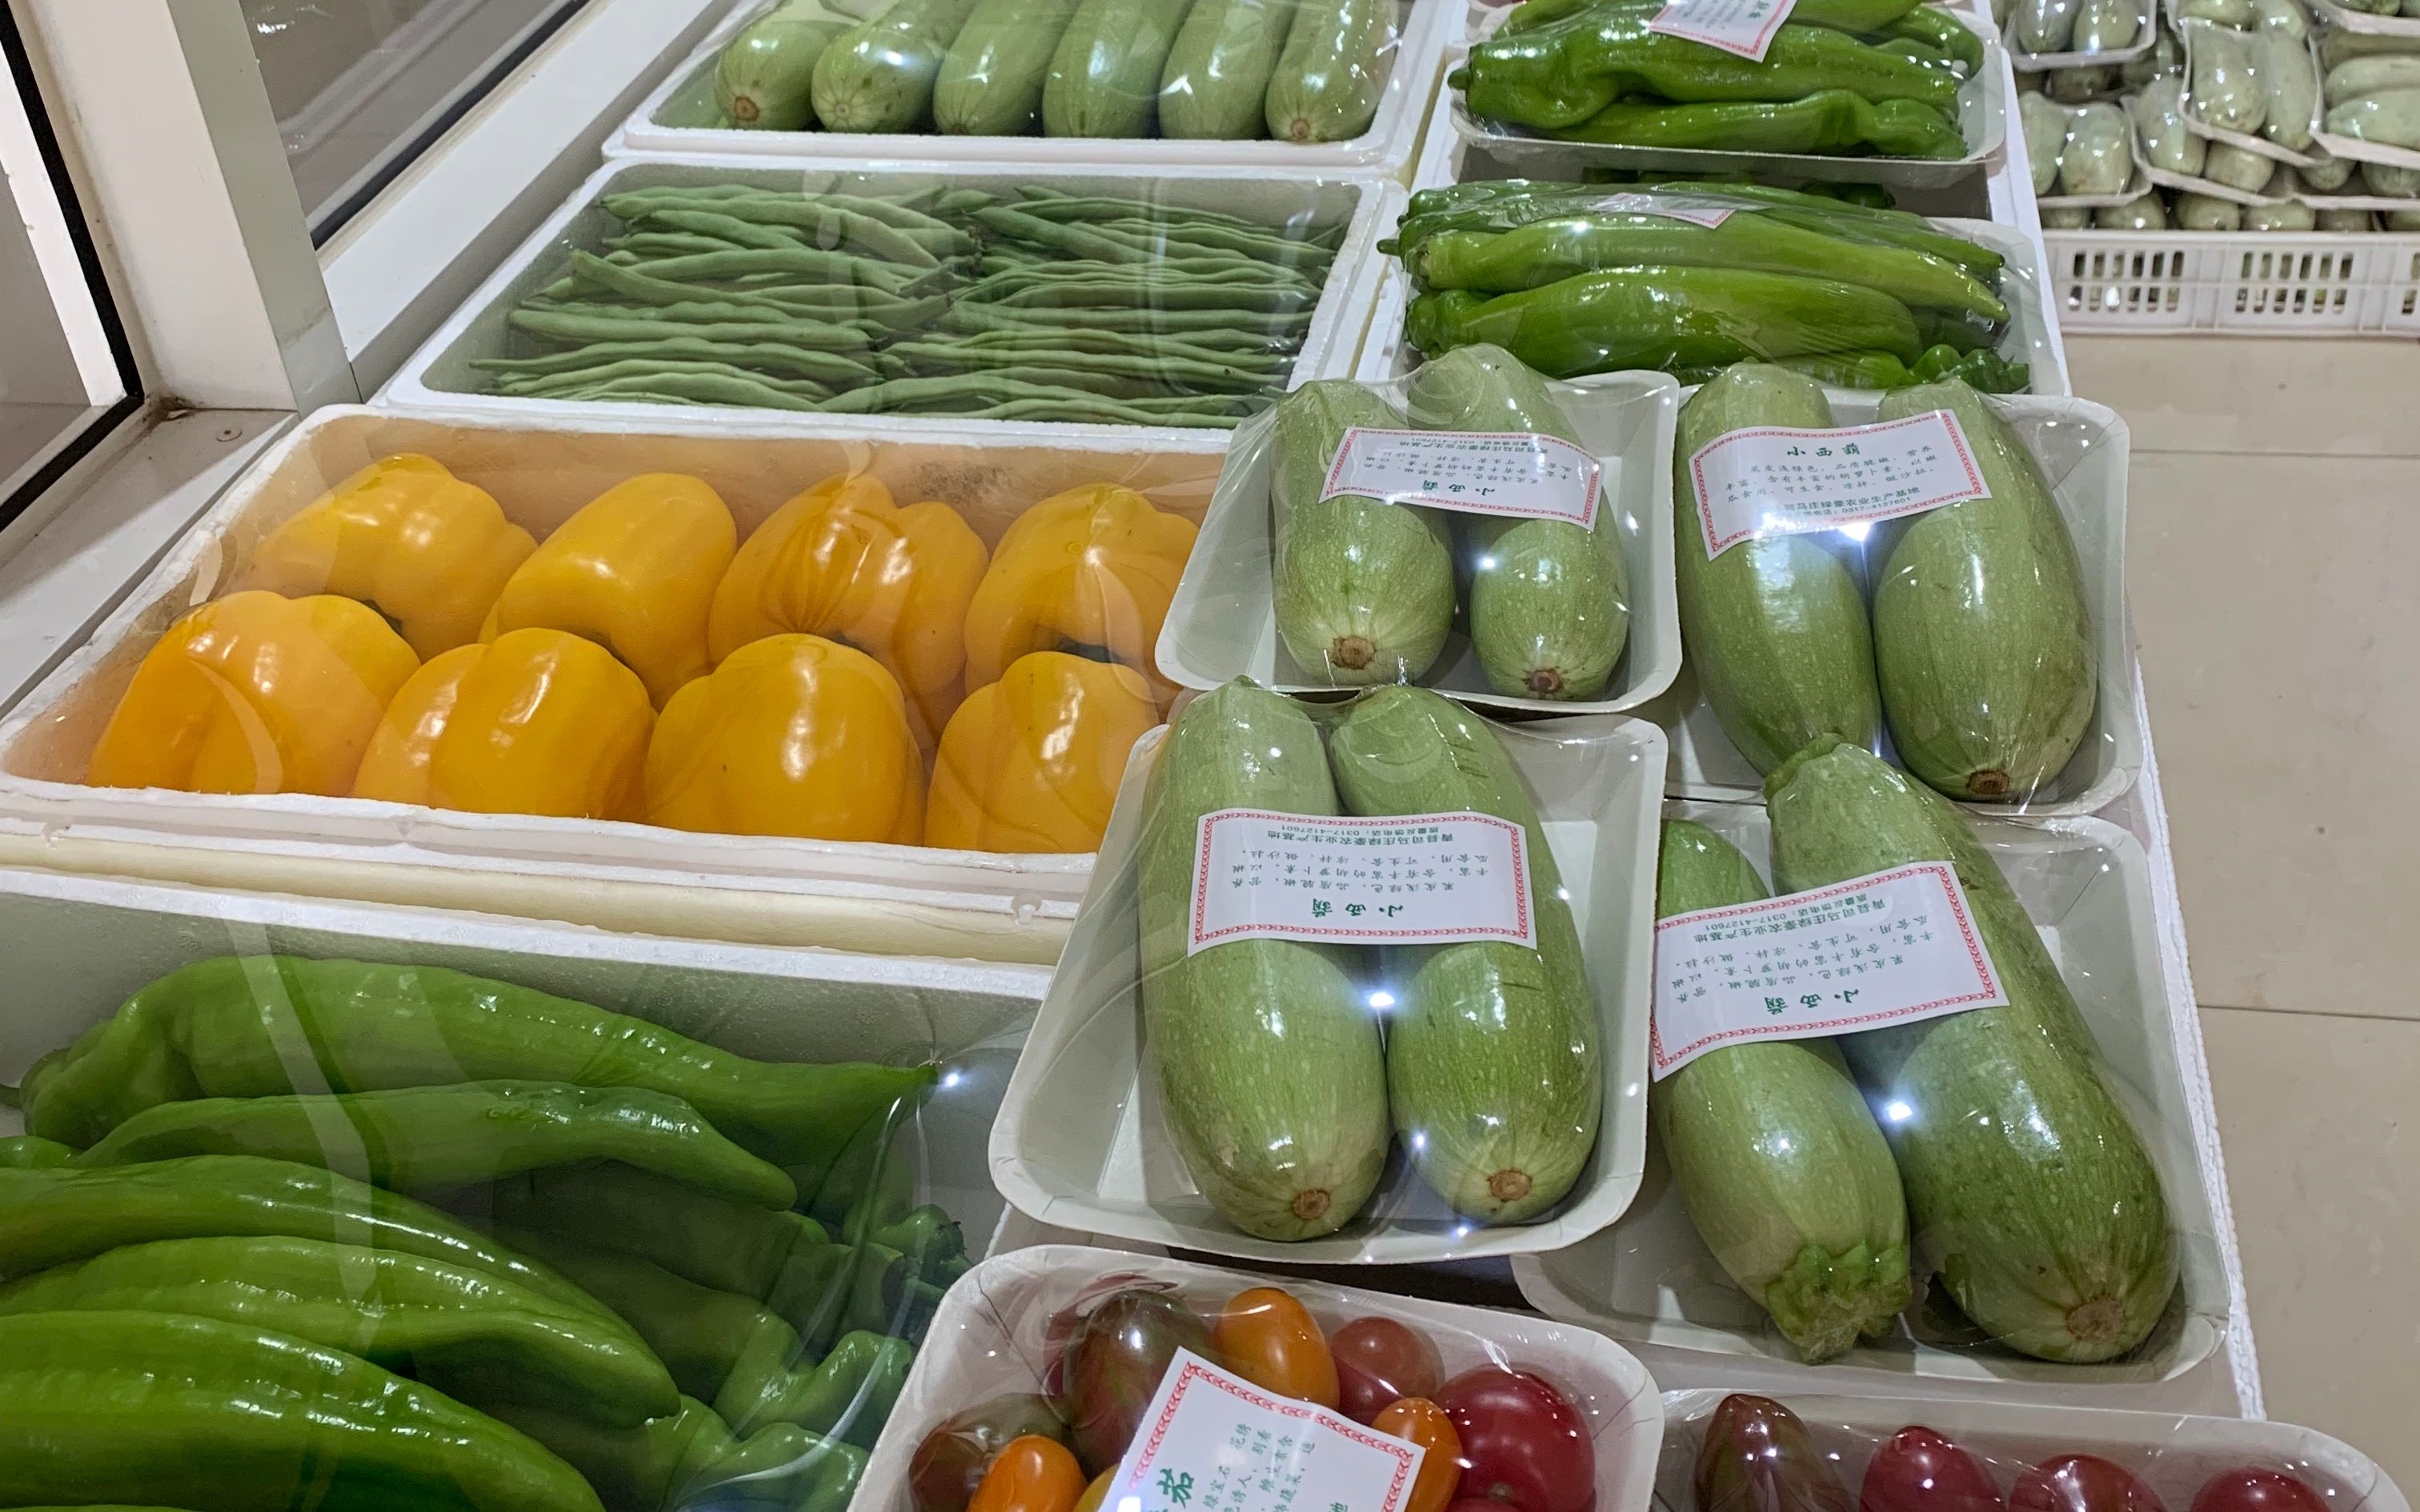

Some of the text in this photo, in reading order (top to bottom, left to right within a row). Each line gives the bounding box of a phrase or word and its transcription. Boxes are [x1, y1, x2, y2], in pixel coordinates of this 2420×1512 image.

[1786, 442, 1861, 457] 小西葫
[1422, 480, 1496, 497] 小西葫
[1267, 830, 1453, 846] 青县司马庄绿豪农业生产基地
[1311, 898, 1403, 918] 小西葫
[1693, 898, 1885, 944] 青县司马庄绿豪农业生产基地
[1764, 988, 1860, 1016] 小西葫
[1149, 1468, 1194, 1512] 茄
